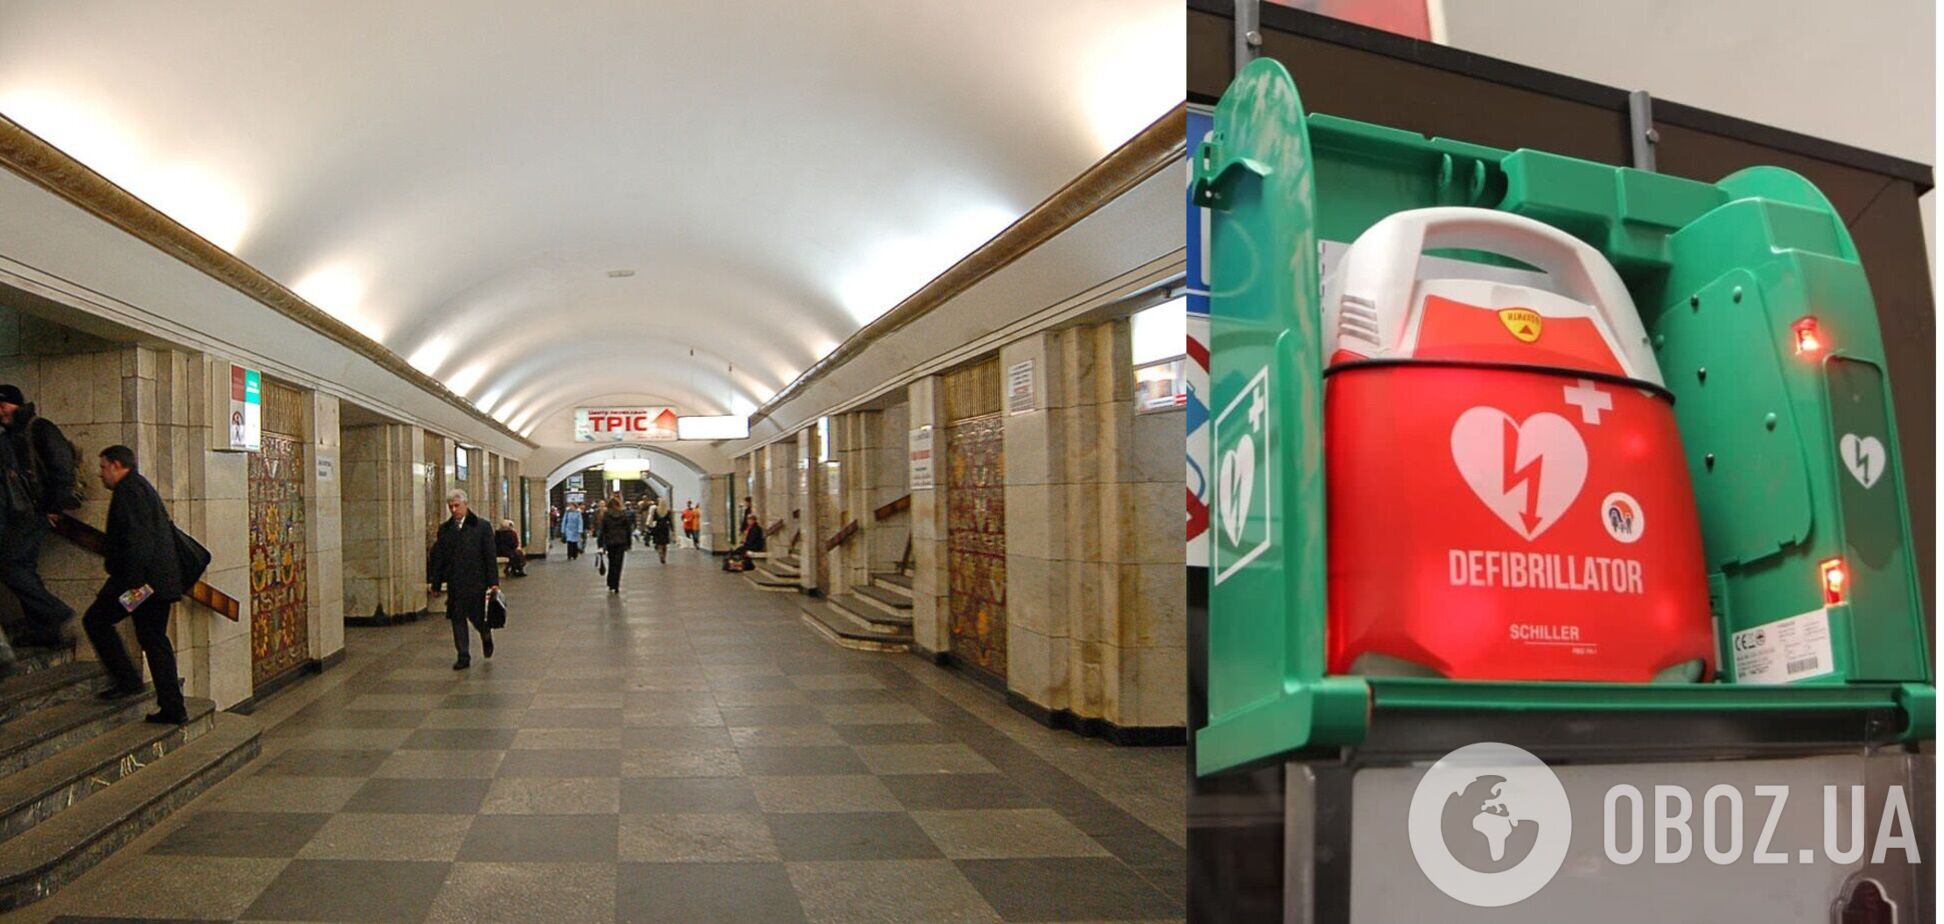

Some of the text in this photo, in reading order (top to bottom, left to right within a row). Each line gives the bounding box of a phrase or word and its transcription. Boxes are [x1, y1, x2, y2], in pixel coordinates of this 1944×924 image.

[588, 416, 648, 432] ТРІС
[1449, 549, 1644, 594] DEFIBRILLATOR
[1509, 624, 1580, 640] SCHILLER
